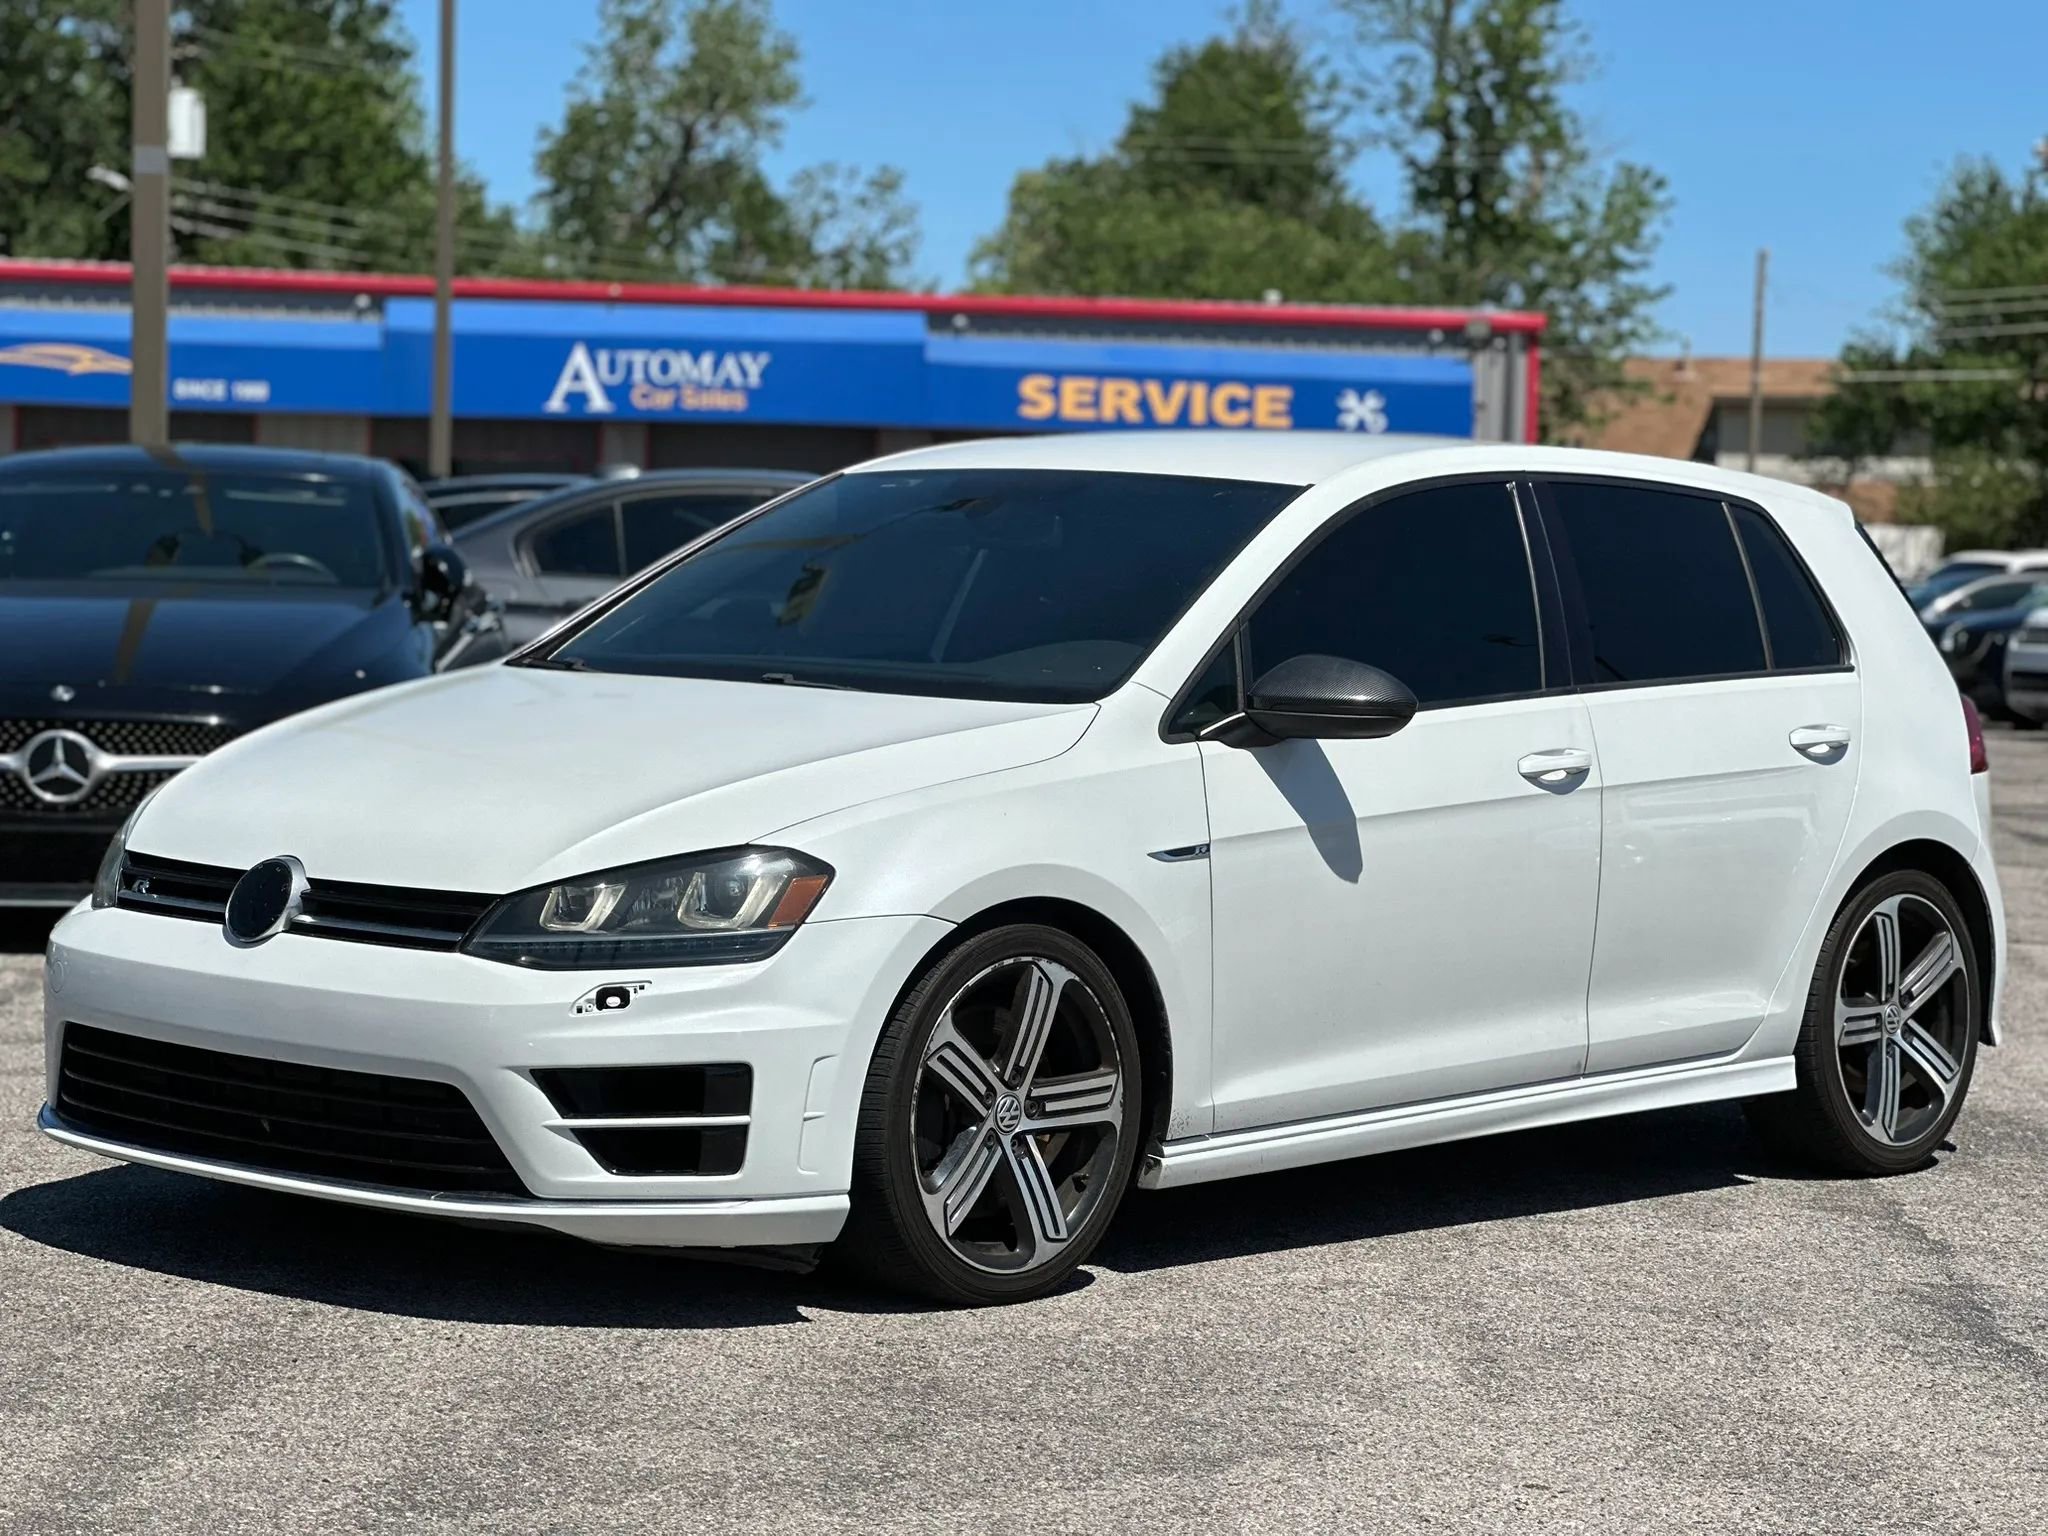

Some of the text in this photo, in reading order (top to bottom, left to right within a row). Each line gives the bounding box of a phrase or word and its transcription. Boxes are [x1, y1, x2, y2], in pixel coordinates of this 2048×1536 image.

[541, 340, 772, 414] AUTOMAY
[629, 383, 677, 410] Car
[1017, 373, 1294, 430] SERVICE
